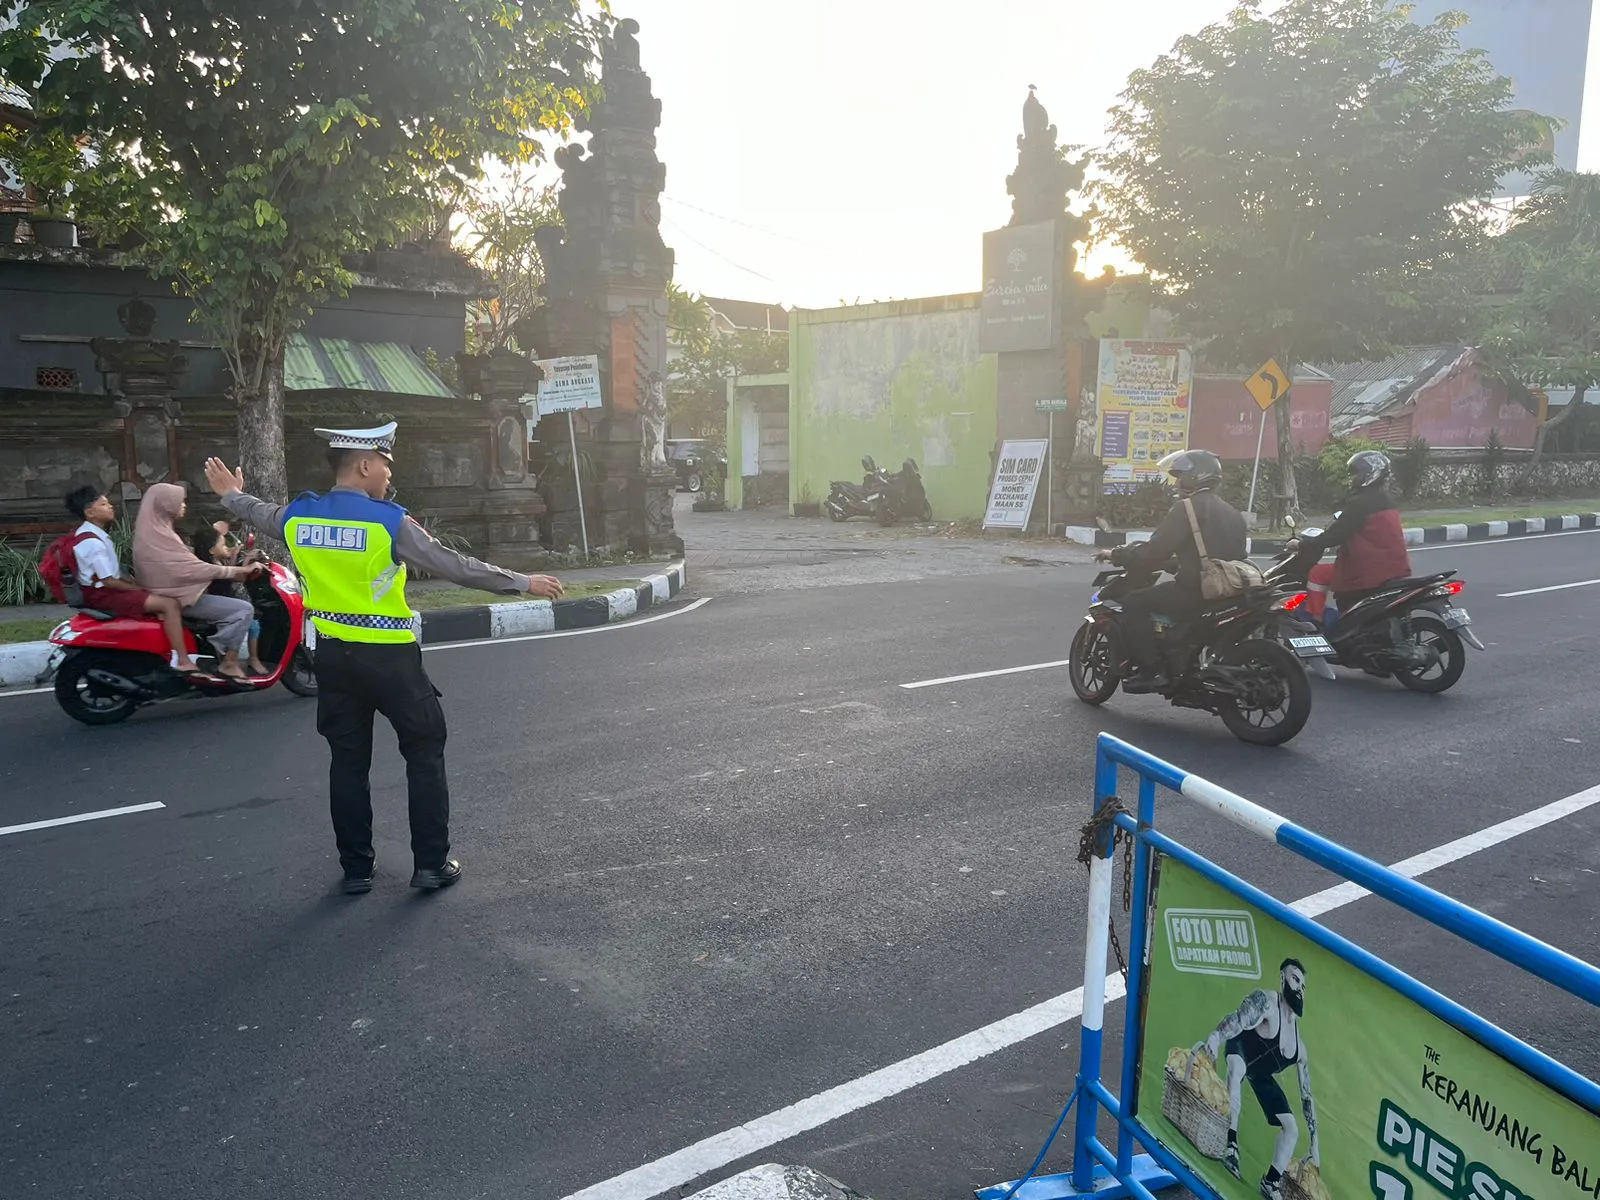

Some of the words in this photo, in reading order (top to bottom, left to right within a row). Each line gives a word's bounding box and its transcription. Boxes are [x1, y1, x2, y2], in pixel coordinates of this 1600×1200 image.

[1000, 458, 1016, 474] SIM
[1016, 458, 1038, 474] CARD
[1001, 485, 1025, 493] MONEY
[297, 525, 363, 549] POLISI
[1171, 917, 1213, 945] FOTO
[1215, 919, 1250, 948] AKU
[1176, 946, 1220, 963] DAPATKAN
[1220, 950, 1252, 967] PROMO
[1424, 1044, 1441, 1066] THE
[1421, 1064, 1542, 1165] KERANJANG
[1383, 1107, 1458, 1191] PIE
